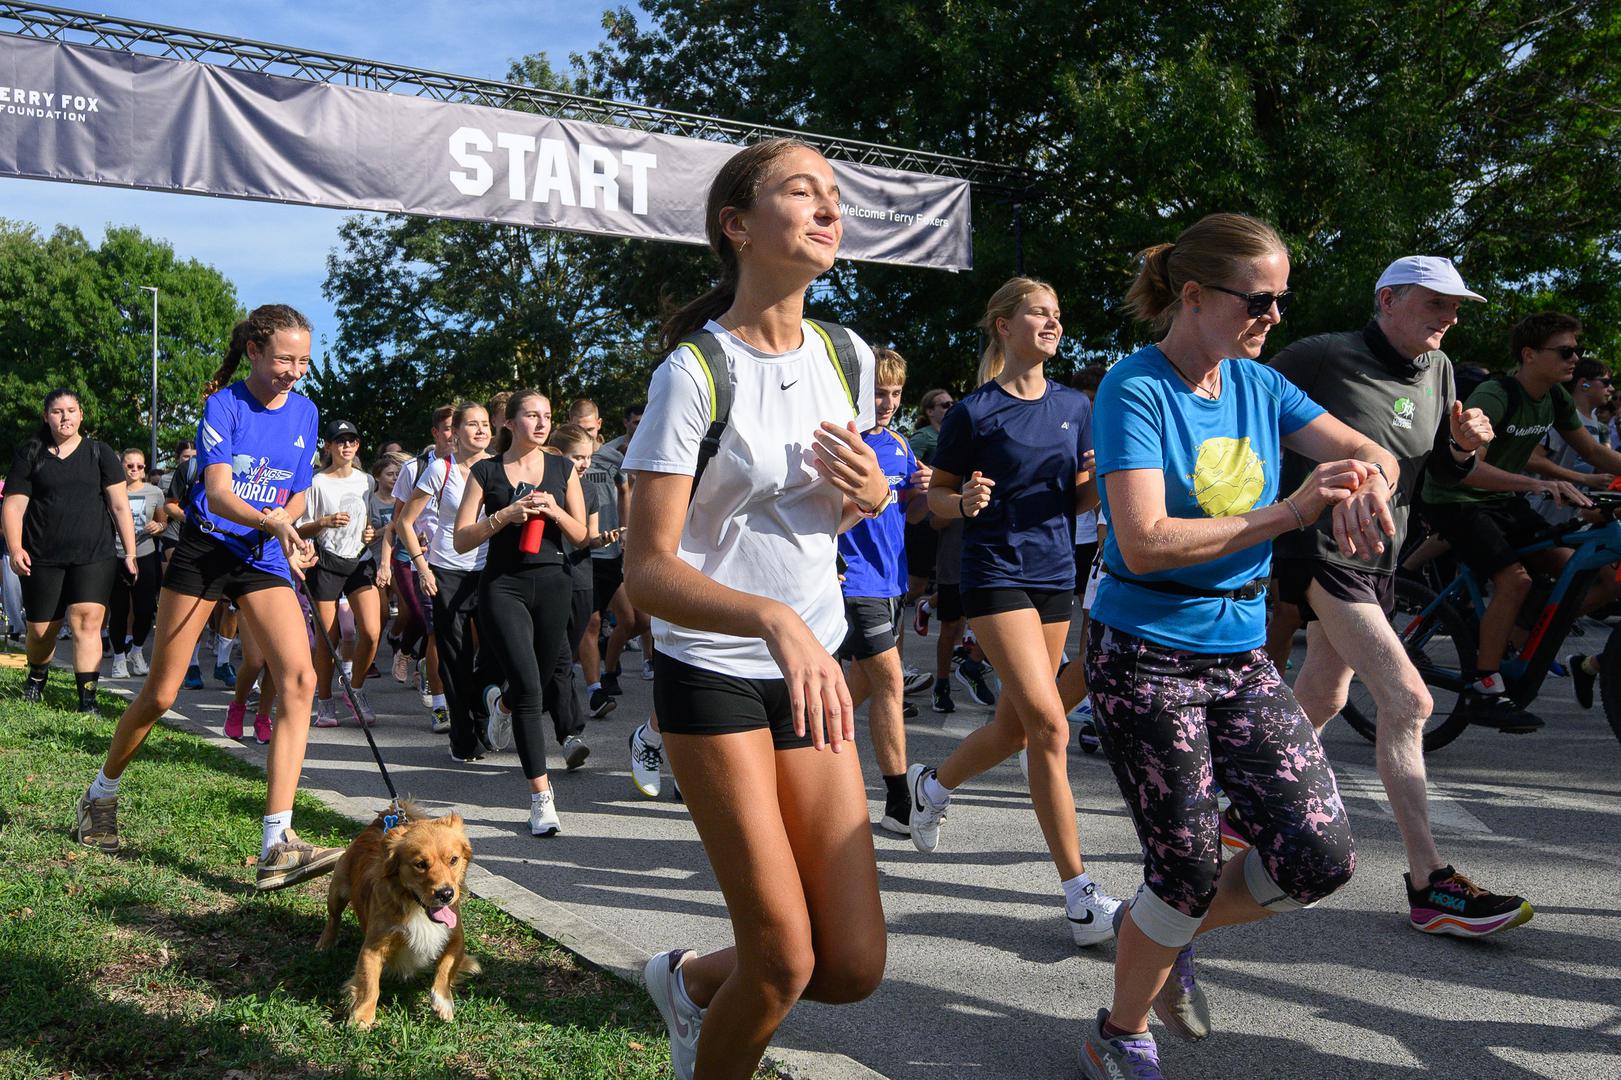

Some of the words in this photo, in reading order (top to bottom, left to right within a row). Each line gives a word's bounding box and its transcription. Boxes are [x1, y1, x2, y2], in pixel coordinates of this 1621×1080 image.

[61, 94, 99, 112] FOX
[449, 126, 657, 215] START
[839, 203, 886, 220] Welcome
[887, 210, 914, 226] Terry
[916, 214, 949, 228] Foxers
[232, 480, 277, 503] WORLD
[1428, 889, 1466, 912] HOKA
[1103, 1052, 1126, 1080] HOK
